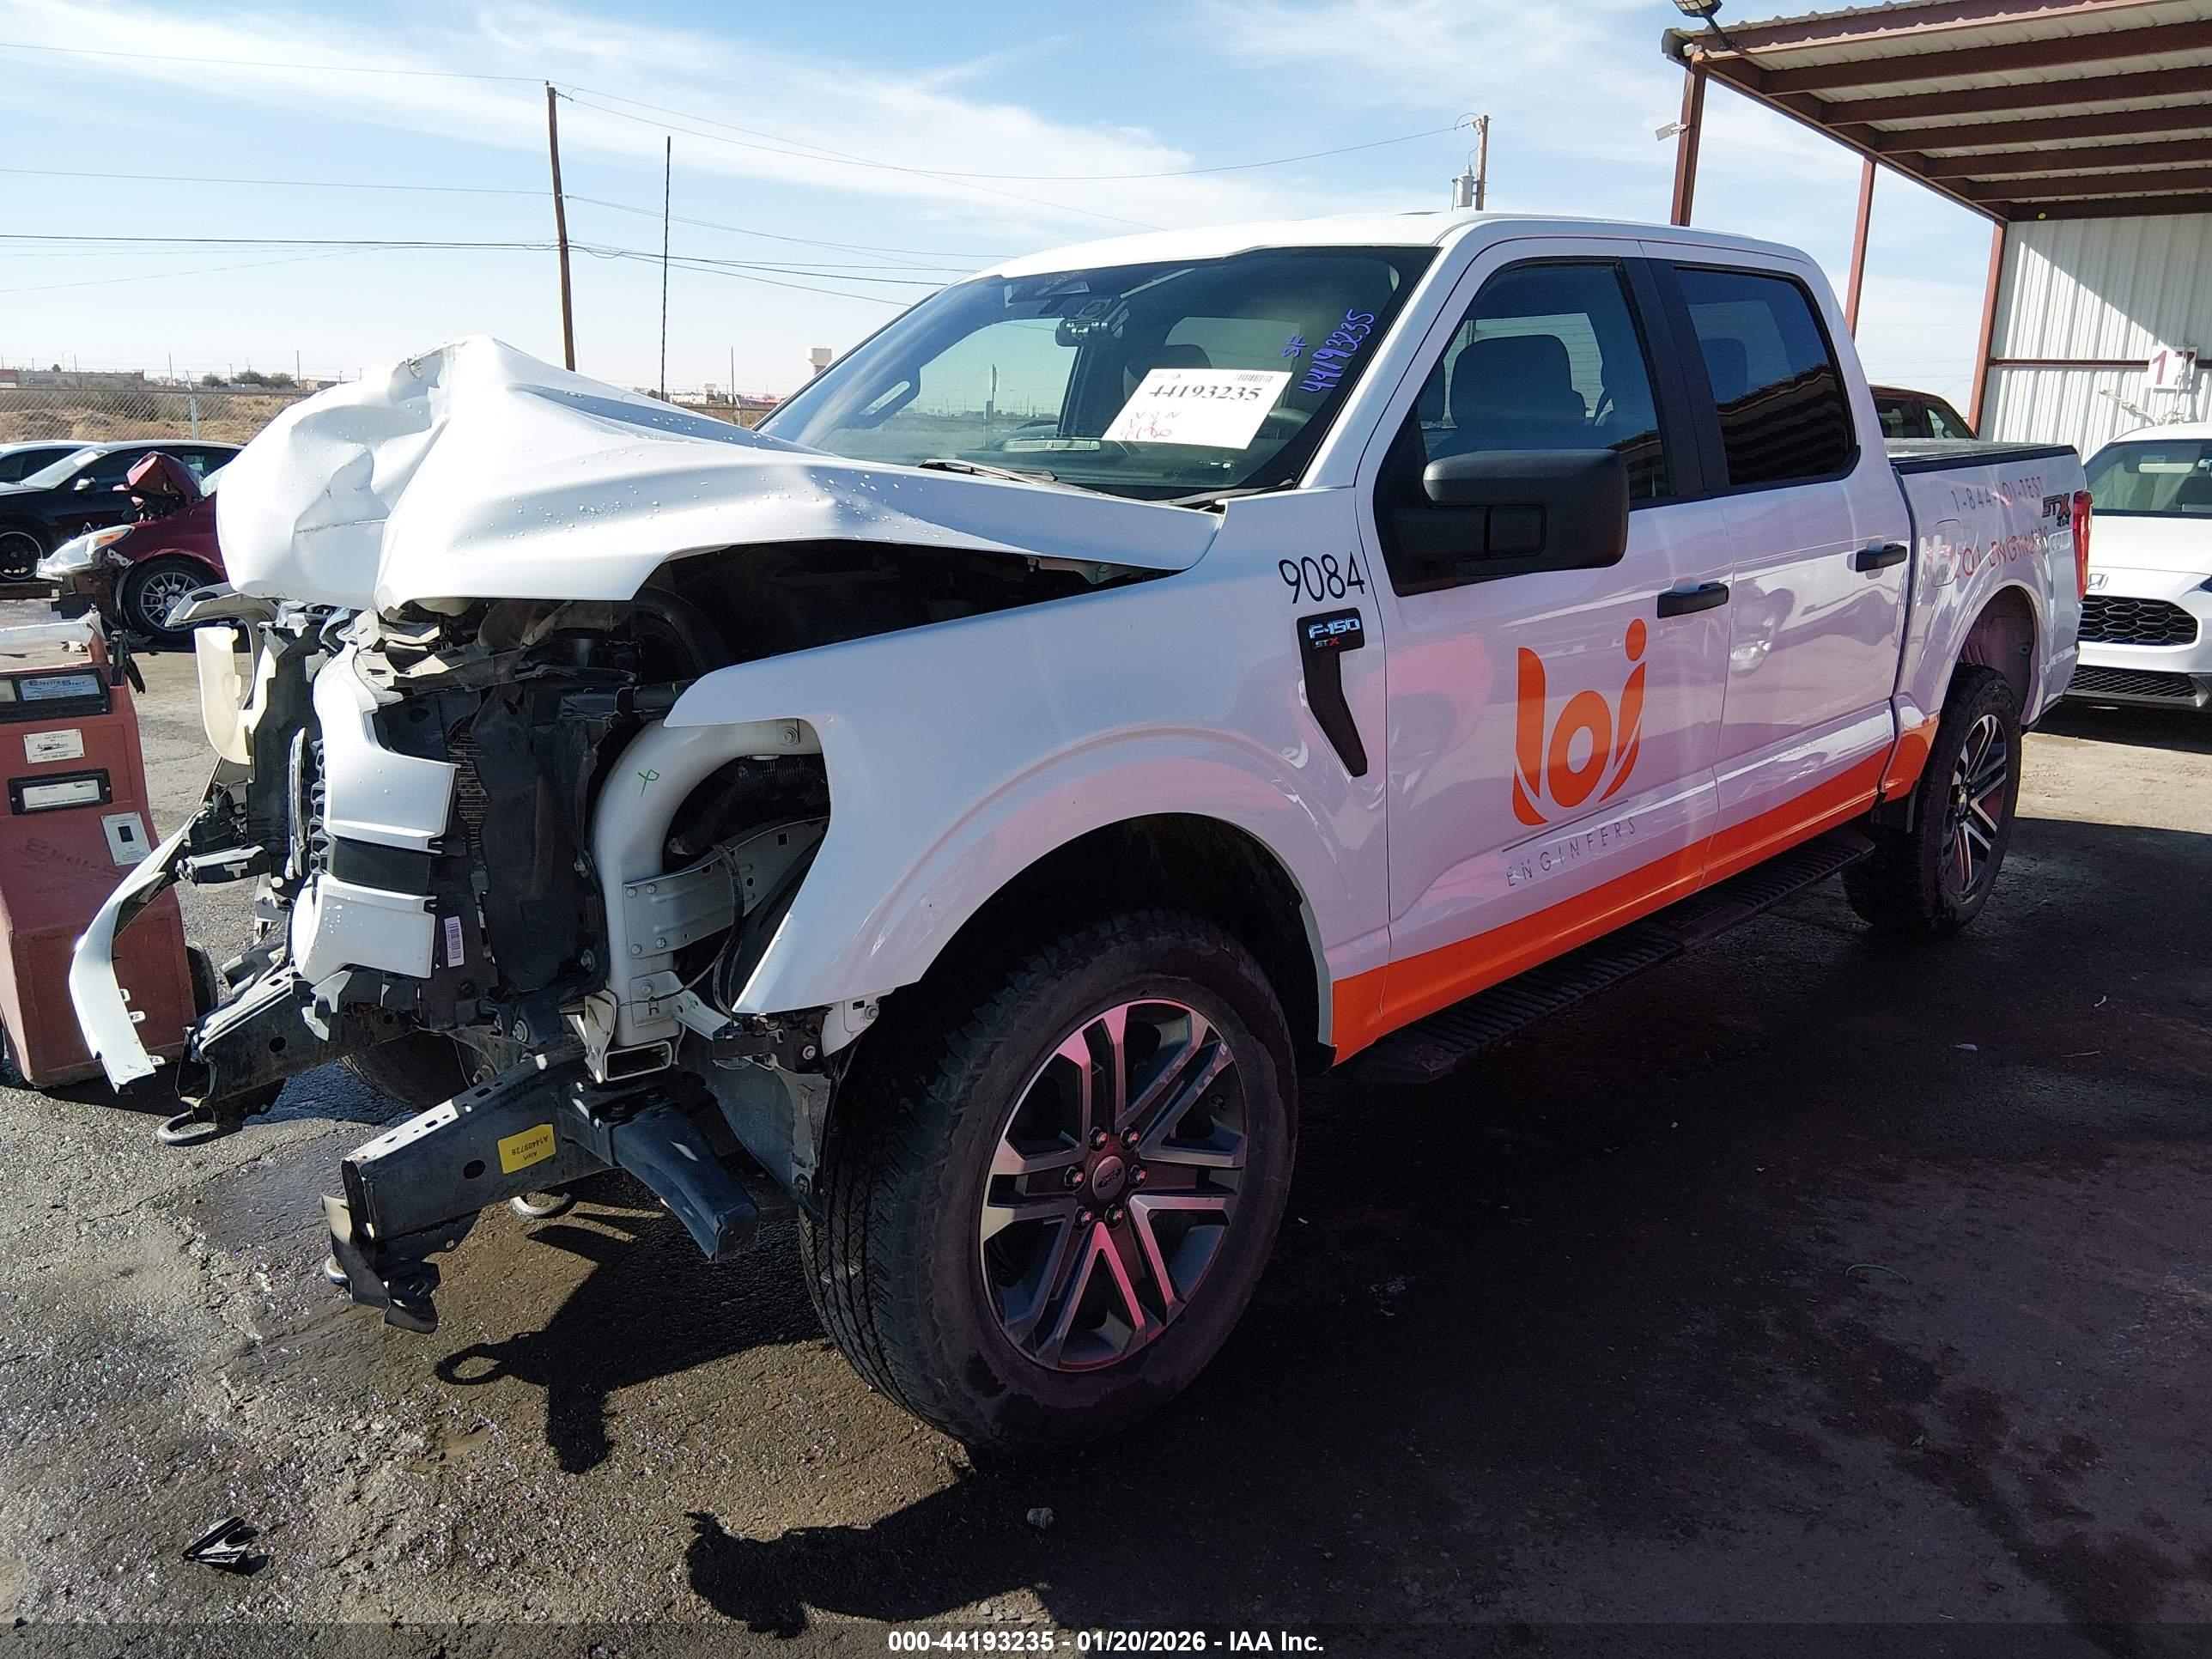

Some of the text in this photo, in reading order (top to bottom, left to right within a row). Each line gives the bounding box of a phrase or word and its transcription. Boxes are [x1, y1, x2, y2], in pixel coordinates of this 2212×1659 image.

[1149, 385, 1263, 400] 44193235
[2042, 493, 2071, 519] STX
[1279, 550, 1365, 604] 9084
[1309, 618, 1360, 639] F-150
[1506, 817, 1636, 886] ENGINEERS
